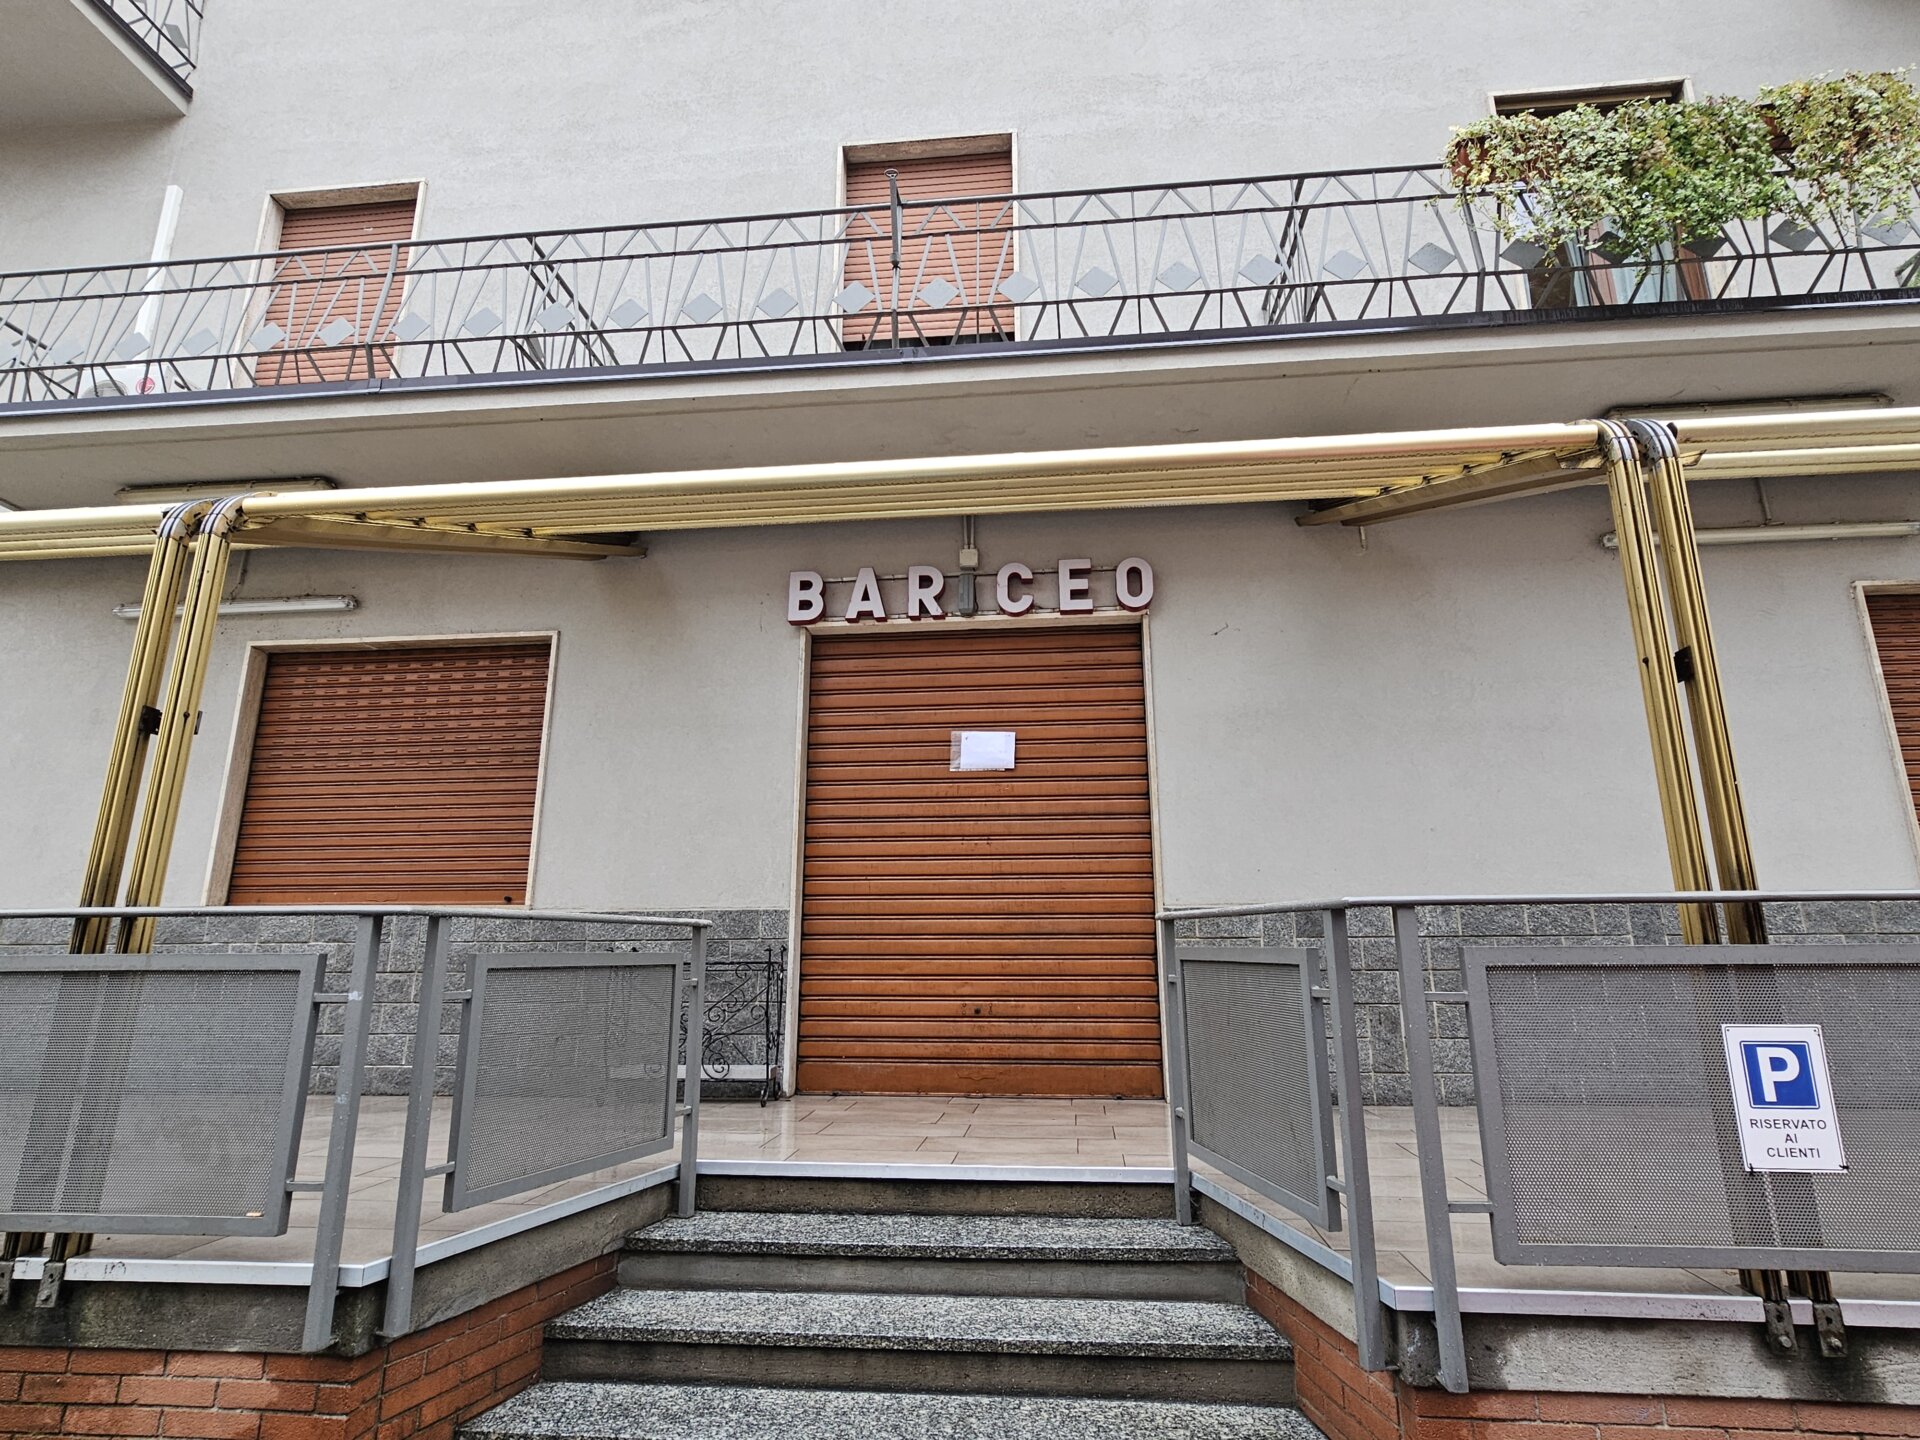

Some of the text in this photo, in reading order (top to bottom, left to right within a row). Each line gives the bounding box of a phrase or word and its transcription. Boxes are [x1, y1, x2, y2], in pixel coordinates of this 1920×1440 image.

[787, 557, 1154, 626] BAR CEO
[1756, 1046, 1800, 1102] P
[1749, 1118, 1827, 1130] RISERVATO
[1784, 1133, 1798, 1144] AI
[1766, 1147, 1821, 1159] CLIENTI
